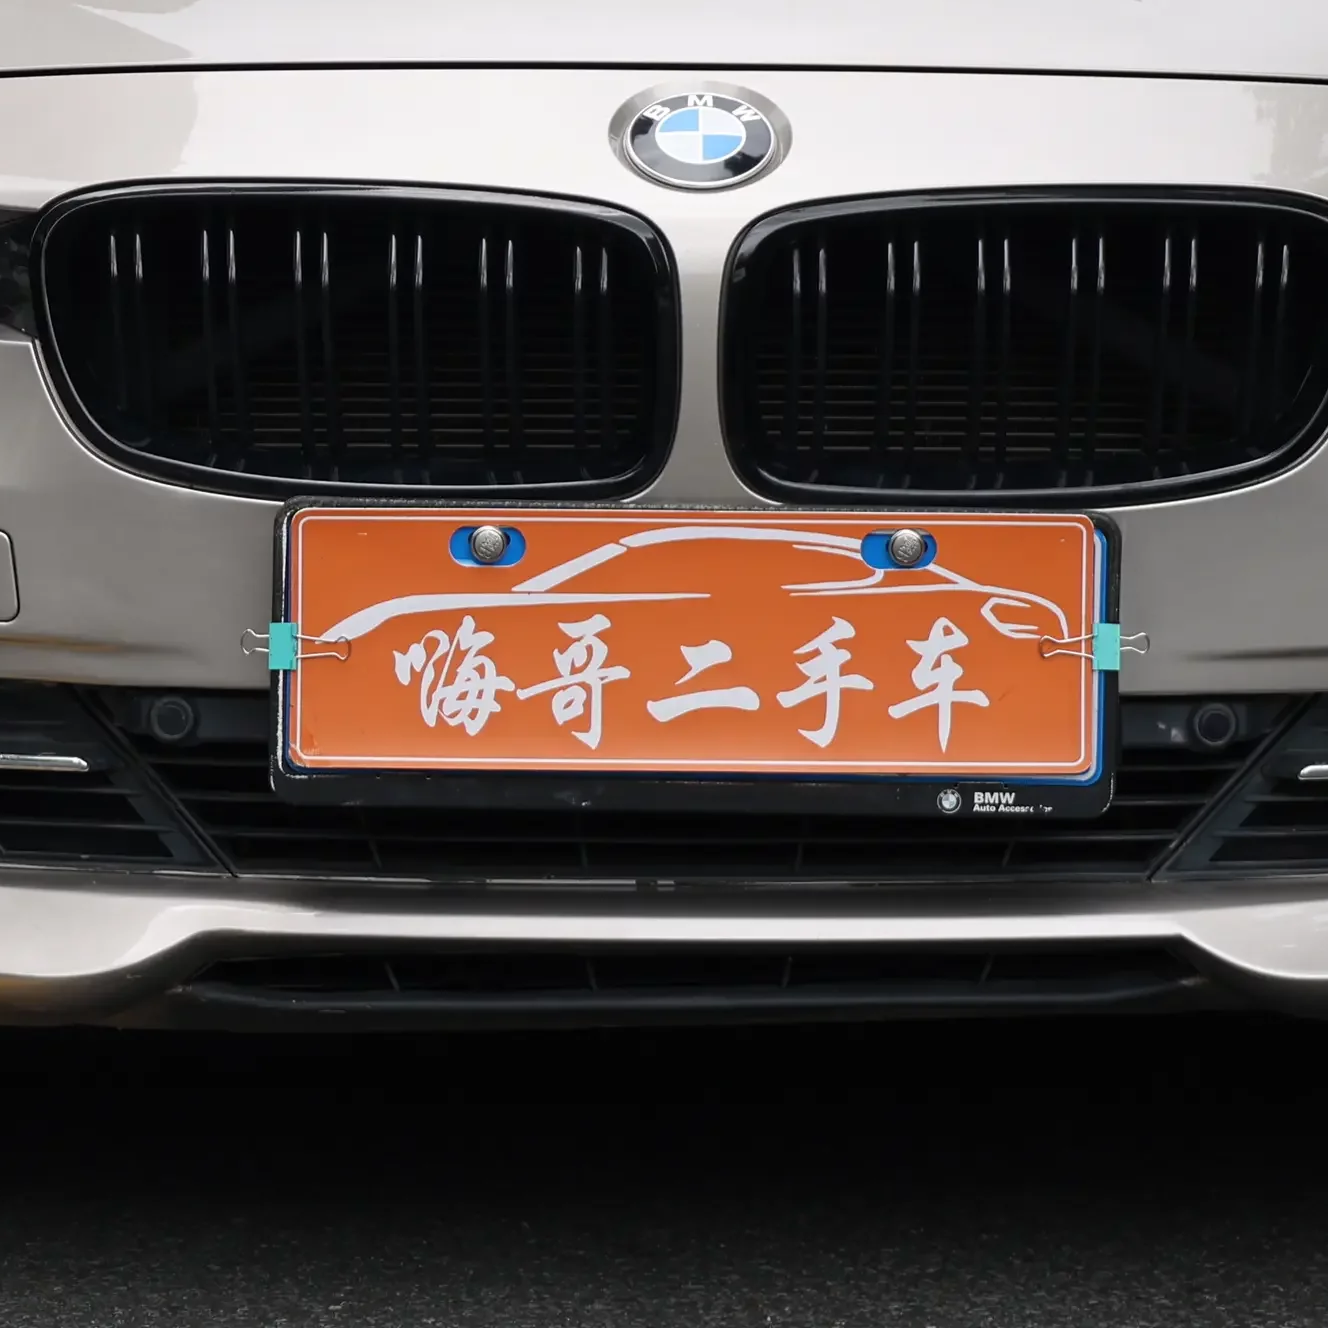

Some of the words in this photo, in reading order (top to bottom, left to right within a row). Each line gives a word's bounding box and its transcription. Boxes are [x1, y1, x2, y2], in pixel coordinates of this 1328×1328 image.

[643, 94, 762, 122] BMW
[393, 615, 990, 752] 嗨哥二手车
[973, 803, 996, 812] Auto
[974, 791, 1015, 804] BMW
